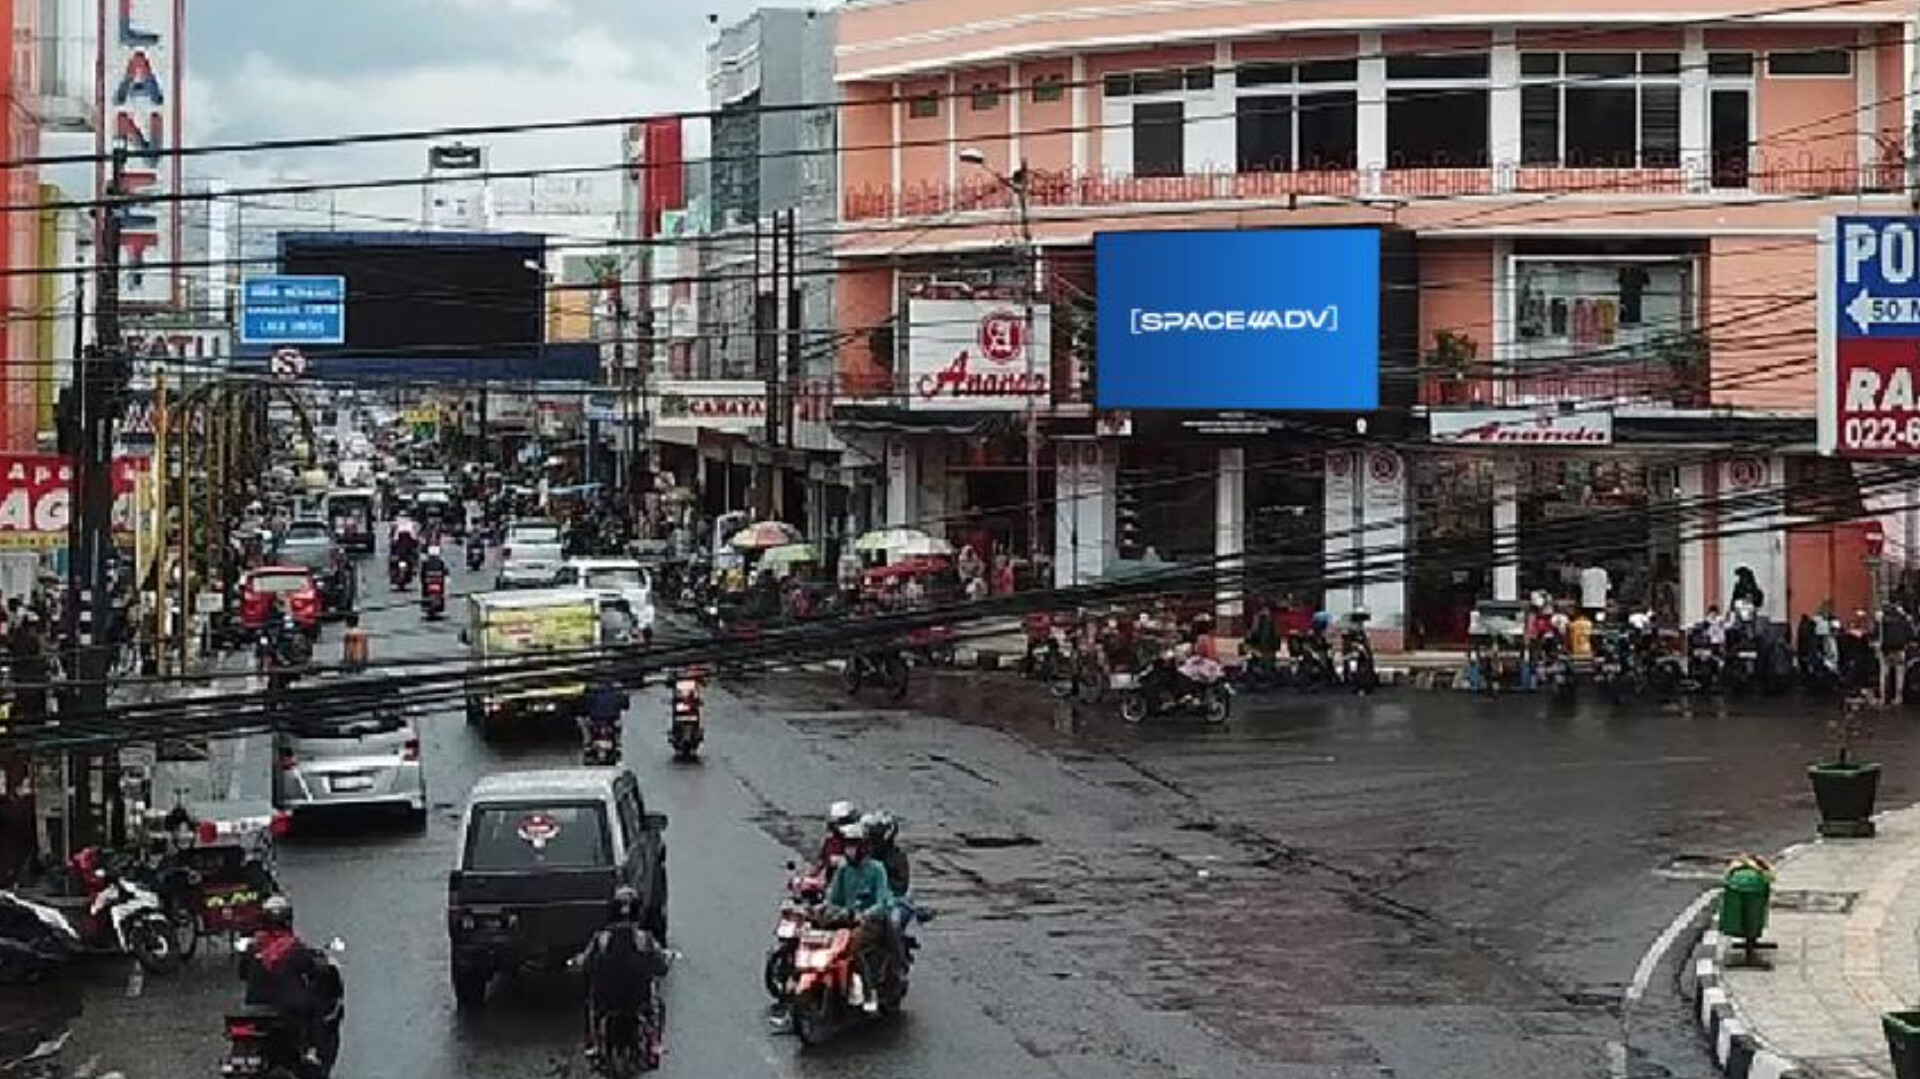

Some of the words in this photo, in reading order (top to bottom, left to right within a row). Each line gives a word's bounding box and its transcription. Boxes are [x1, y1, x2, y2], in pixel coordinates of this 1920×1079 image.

[1845, 223, 1920, 284] PO
[1872, 300, 1902, 321] 50
[1845, 367, 1920, 412] RA
[689, 400, 765, 419] CAHAYA
[1432, 422, 1605, 441] Ananda
